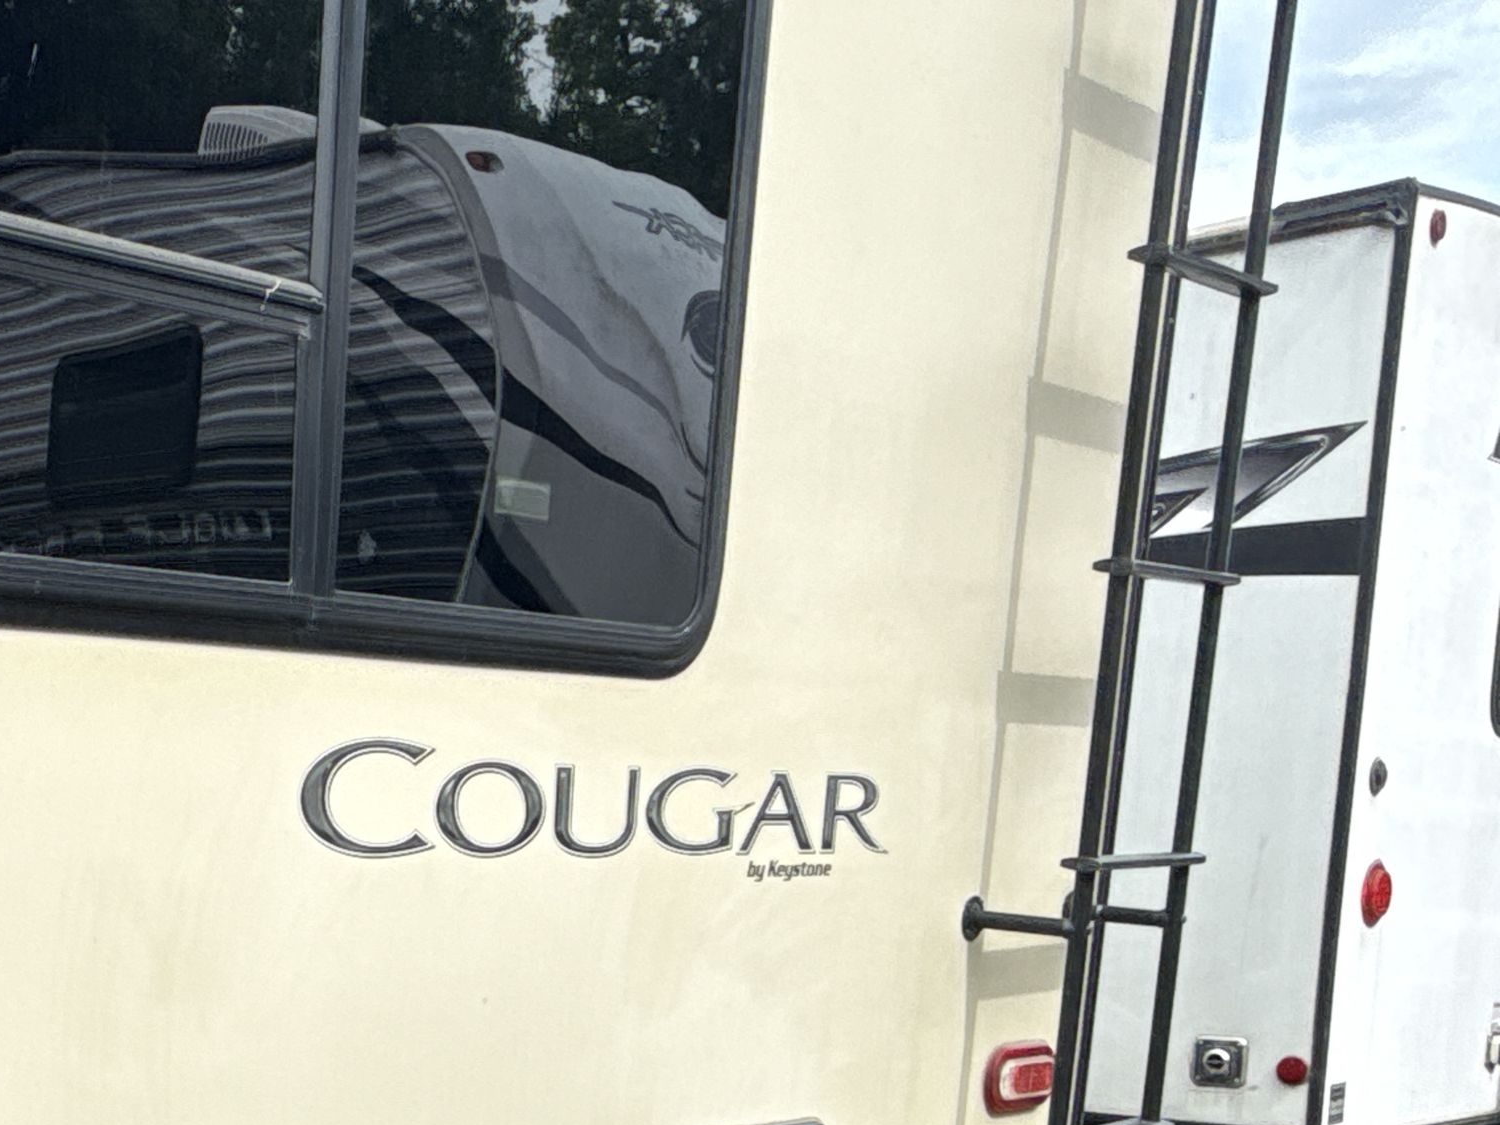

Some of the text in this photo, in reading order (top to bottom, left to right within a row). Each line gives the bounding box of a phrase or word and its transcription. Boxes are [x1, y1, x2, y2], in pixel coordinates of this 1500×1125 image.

[299, 737, 889, 858] COUGAR
[746, 860, 832, 882] by Keystone
